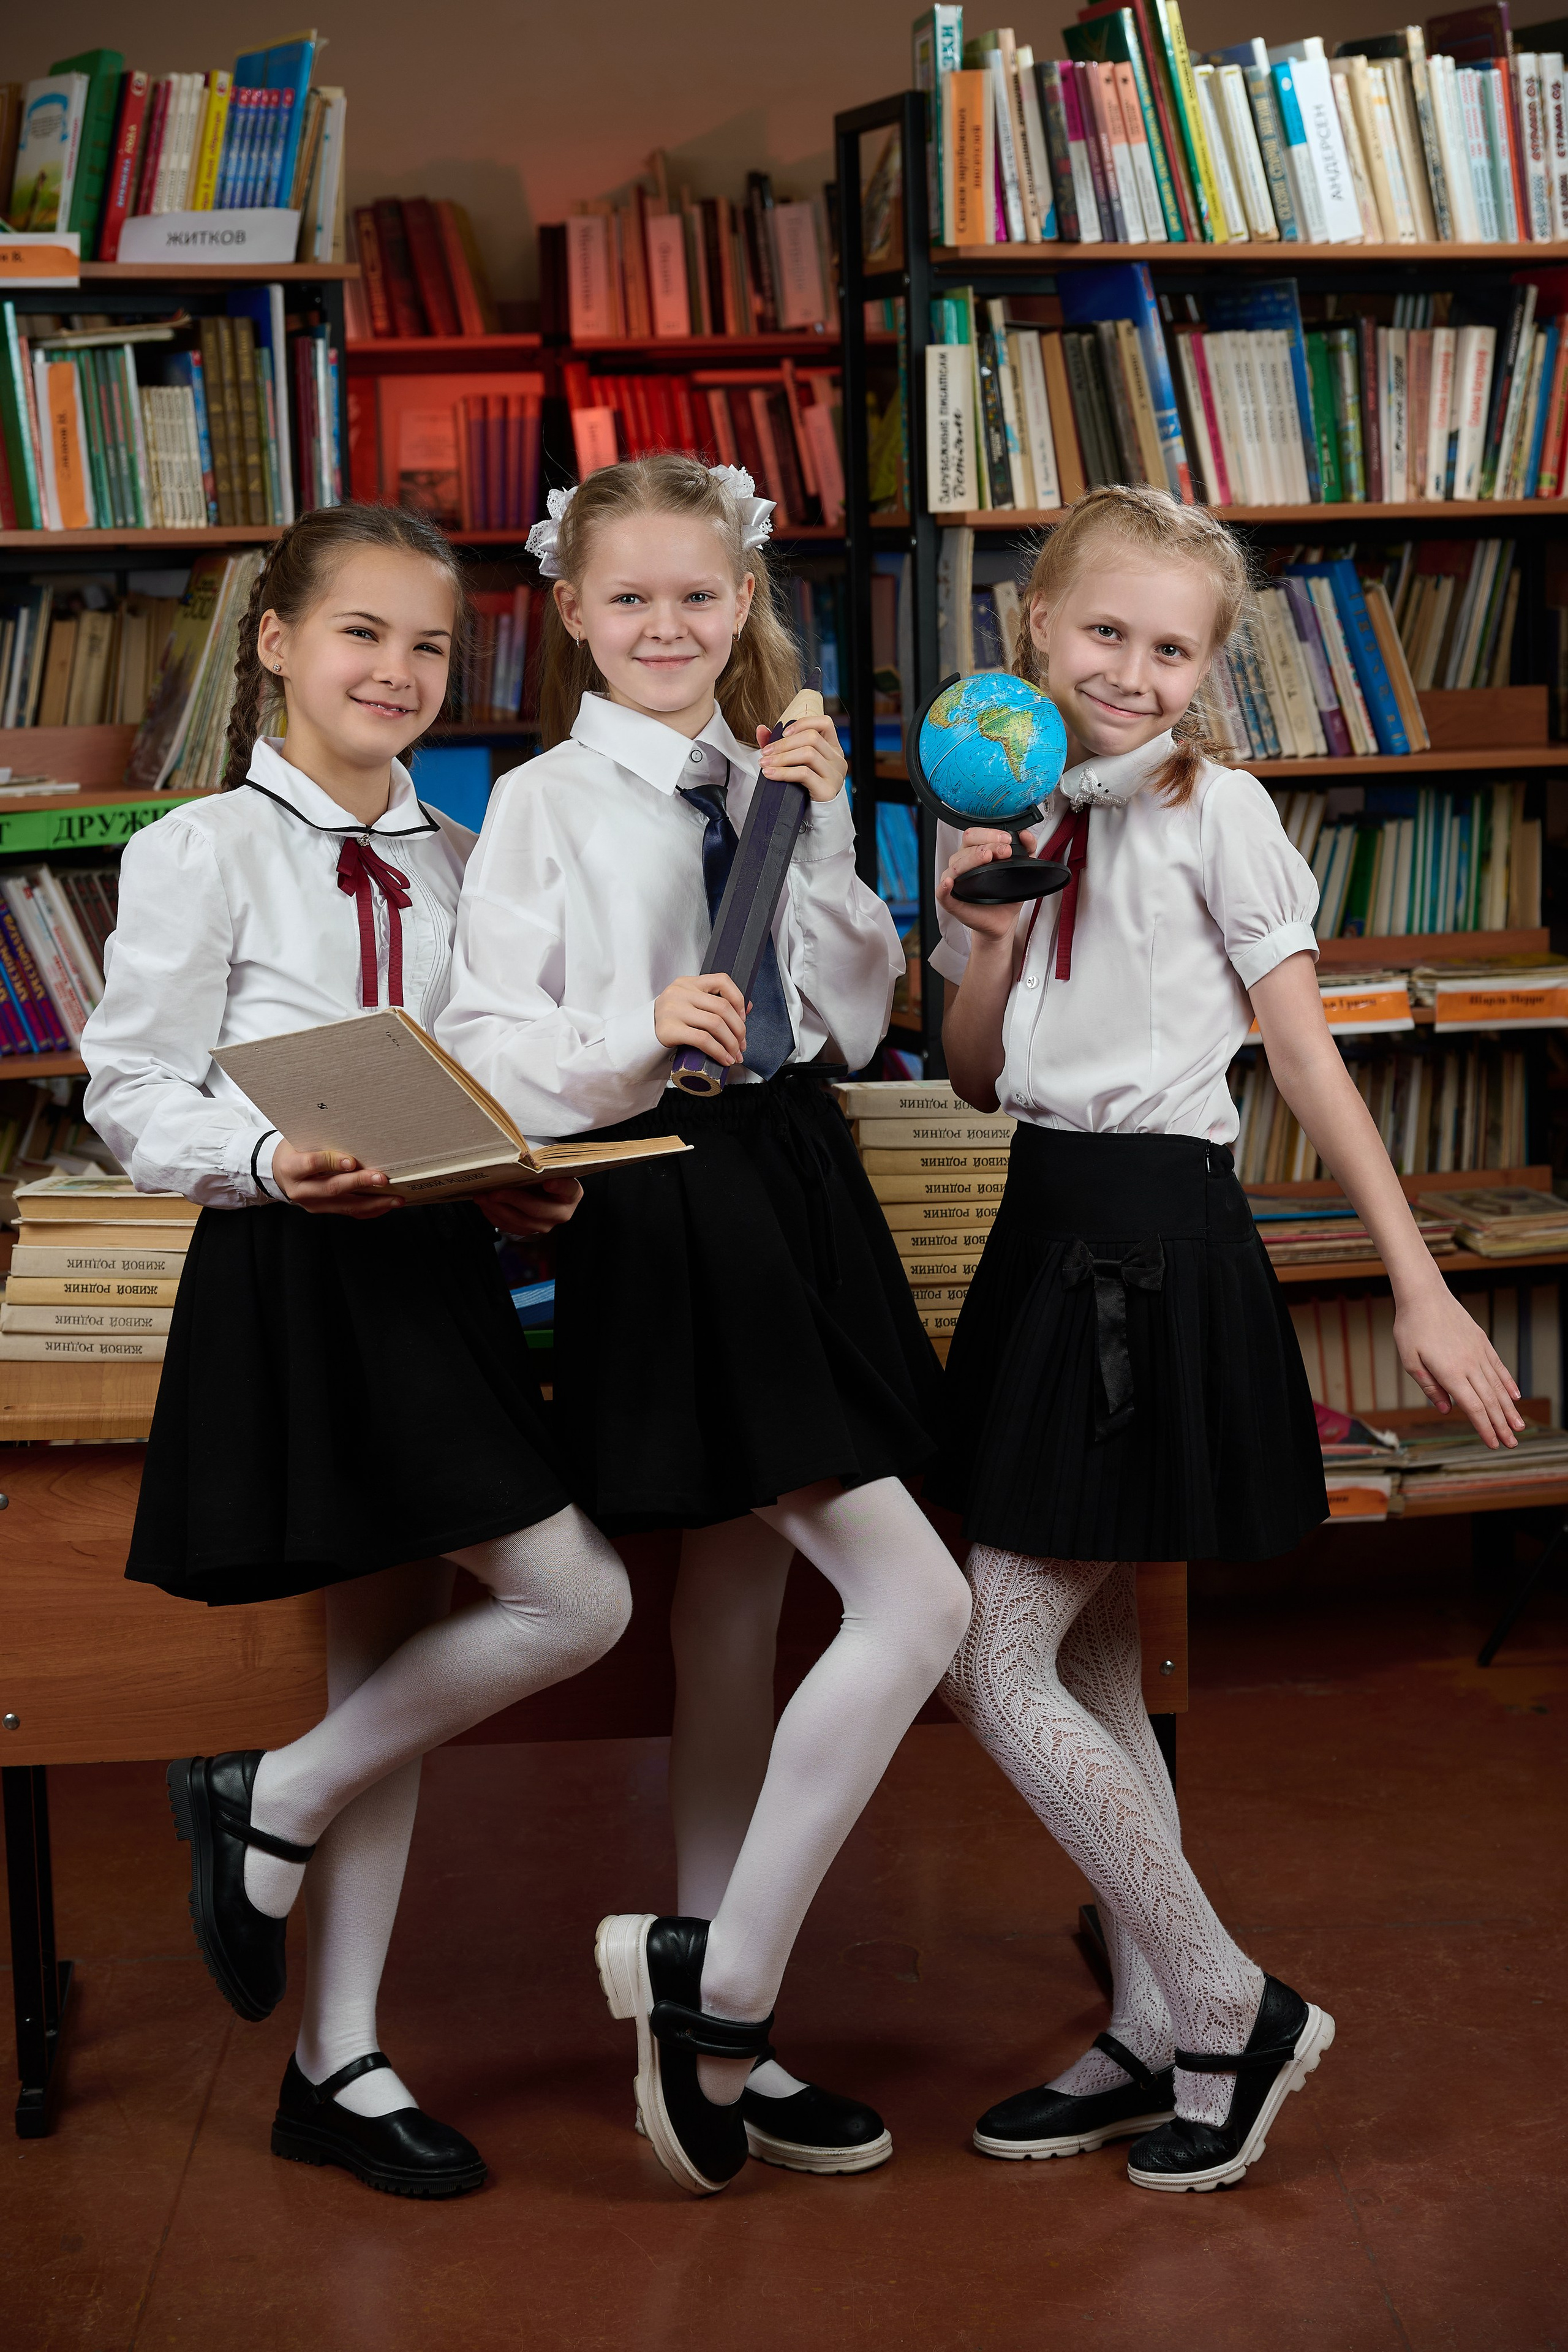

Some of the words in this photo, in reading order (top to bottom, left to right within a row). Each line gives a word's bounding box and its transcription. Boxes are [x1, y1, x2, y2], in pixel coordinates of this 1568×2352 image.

[956, 107, 968, 183] зарубежных
[1313, 103, 1344, 202] АНДЕРСЕН
[956, 187, 968, 234] Сказки
[166, 229, 247, 246] ЖИТКОВ
[1469, 994, 1507, 1007] Шарль
[1510, 994, 1545, 1007] Перро
[900, 1099, 948, 1109] РОДНИК
[913, 1128, 962, 1139] РОДНИК
[967, 1129, 1011, 1140] ЖИВОЙ
[921, 1157, 967, 1167] РОДНИК
[925, 1183, 971, 1194] РОДНИК
[977, 1183, 1006, 1194] ИВОЙ
[923, 1207, 970, 1219] РОДНИК
[976, 1208, 998, 1218] ВОЙ
[911, 1234, 958, 1246] РОДНИК
[963, 1235, 987, 1246] ВОЙ
[67, 1259, 116, 1270] РОДНИК
[122, 1261, 165, 1271] ЖИВОЙ
[910, 1263, 957, 1275] РОДНИК
[64, 1283, 111, 1294] РОДНИК
[116, 1285, 158, 1295] ЖИВОЙ
[911, 1289, 942, 1300] РОДН
[947, 1289, 969, 1300] ВОЙ
[55, 1315, 104, 1326] РОДНИК
[110, 1316, 153, 1327] ЖИВОЙ
[935, 1317, 957, 1328] ВОЙ
[45, 1341, 94, 1353] РОДНИК
[100, 1344, 143, 1355] ЖИВОЙ
